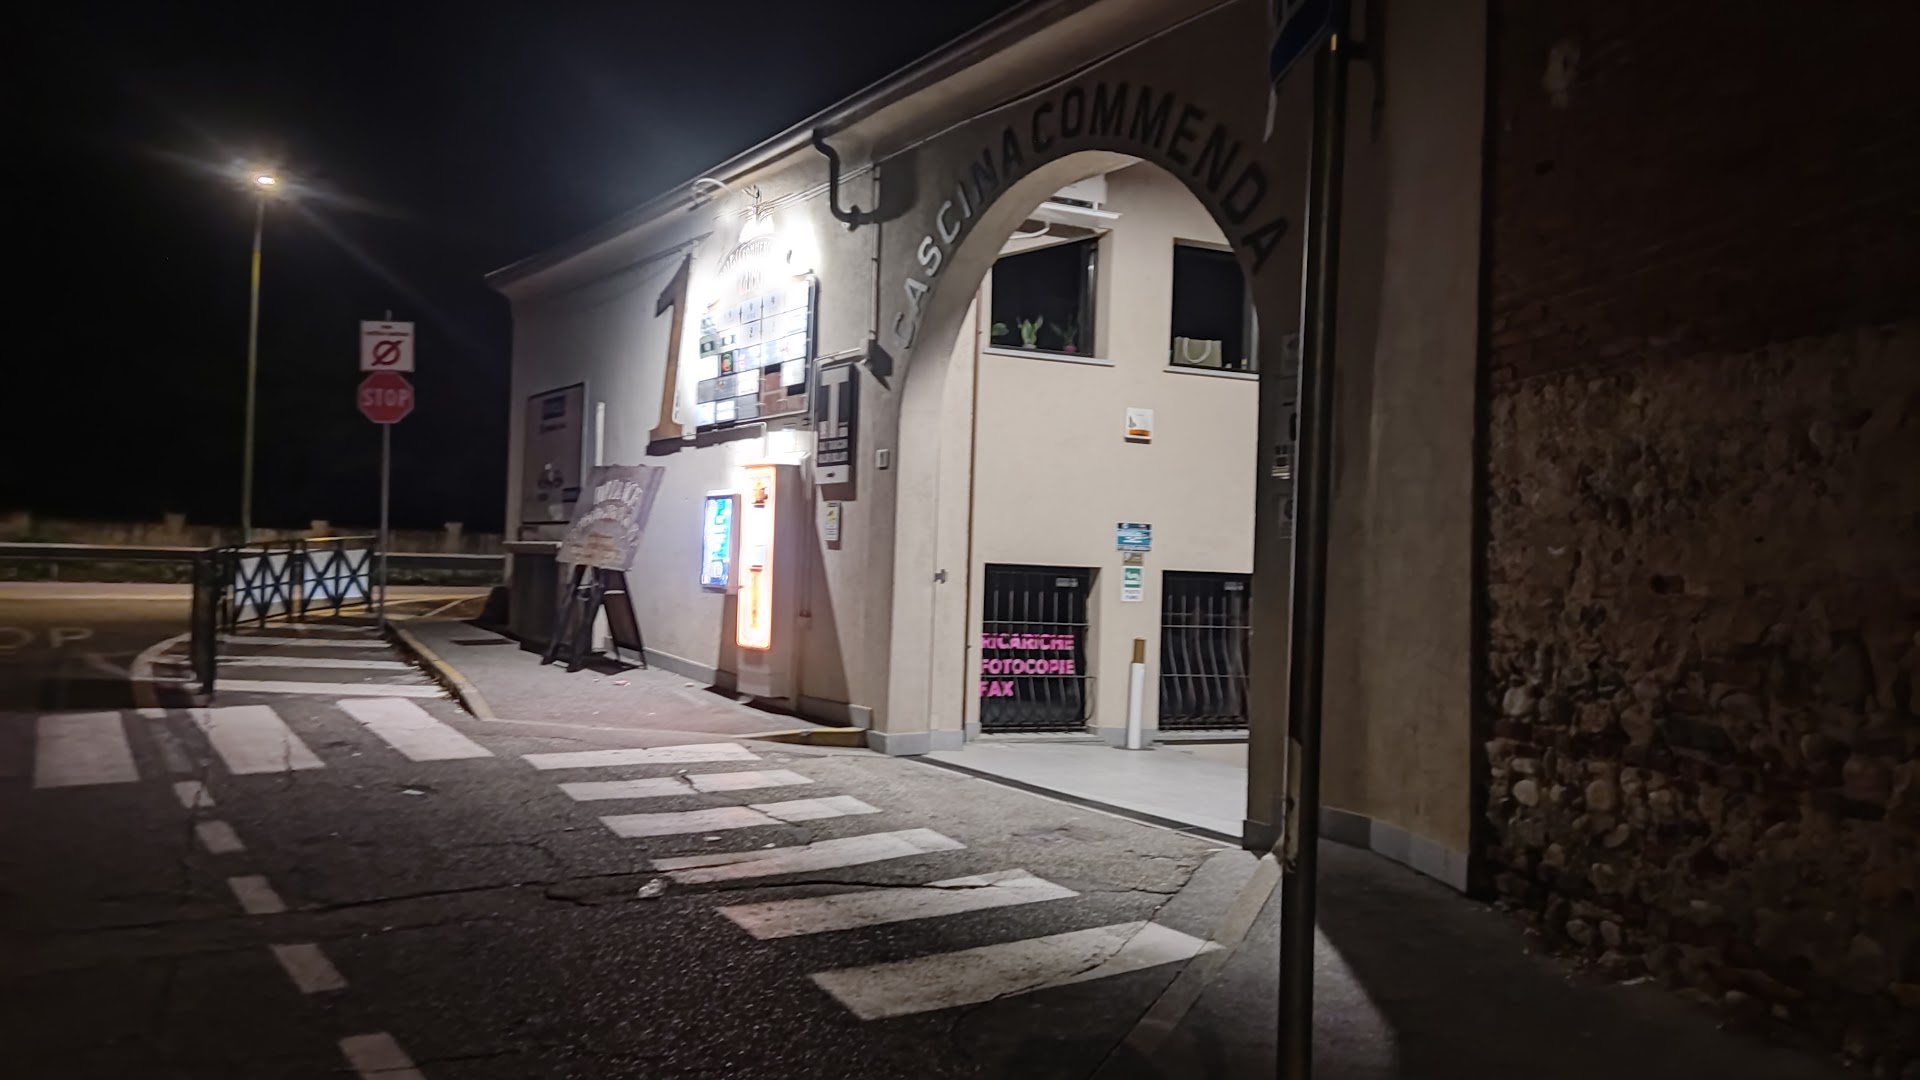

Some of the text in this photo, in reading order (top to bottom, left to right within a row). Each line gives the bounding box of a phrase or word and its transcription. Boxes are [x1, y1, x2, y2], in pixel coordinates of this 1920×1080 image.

[893, 82, 1288, 349] CASCINA COMMENDA
[362, 388, 408, 407] STOP
[981, 633, 1074, 650] RICARICHE
[981, 658, 1075, 675] FOTOCOPIE
[979, 681, 1014, 697] FAX
